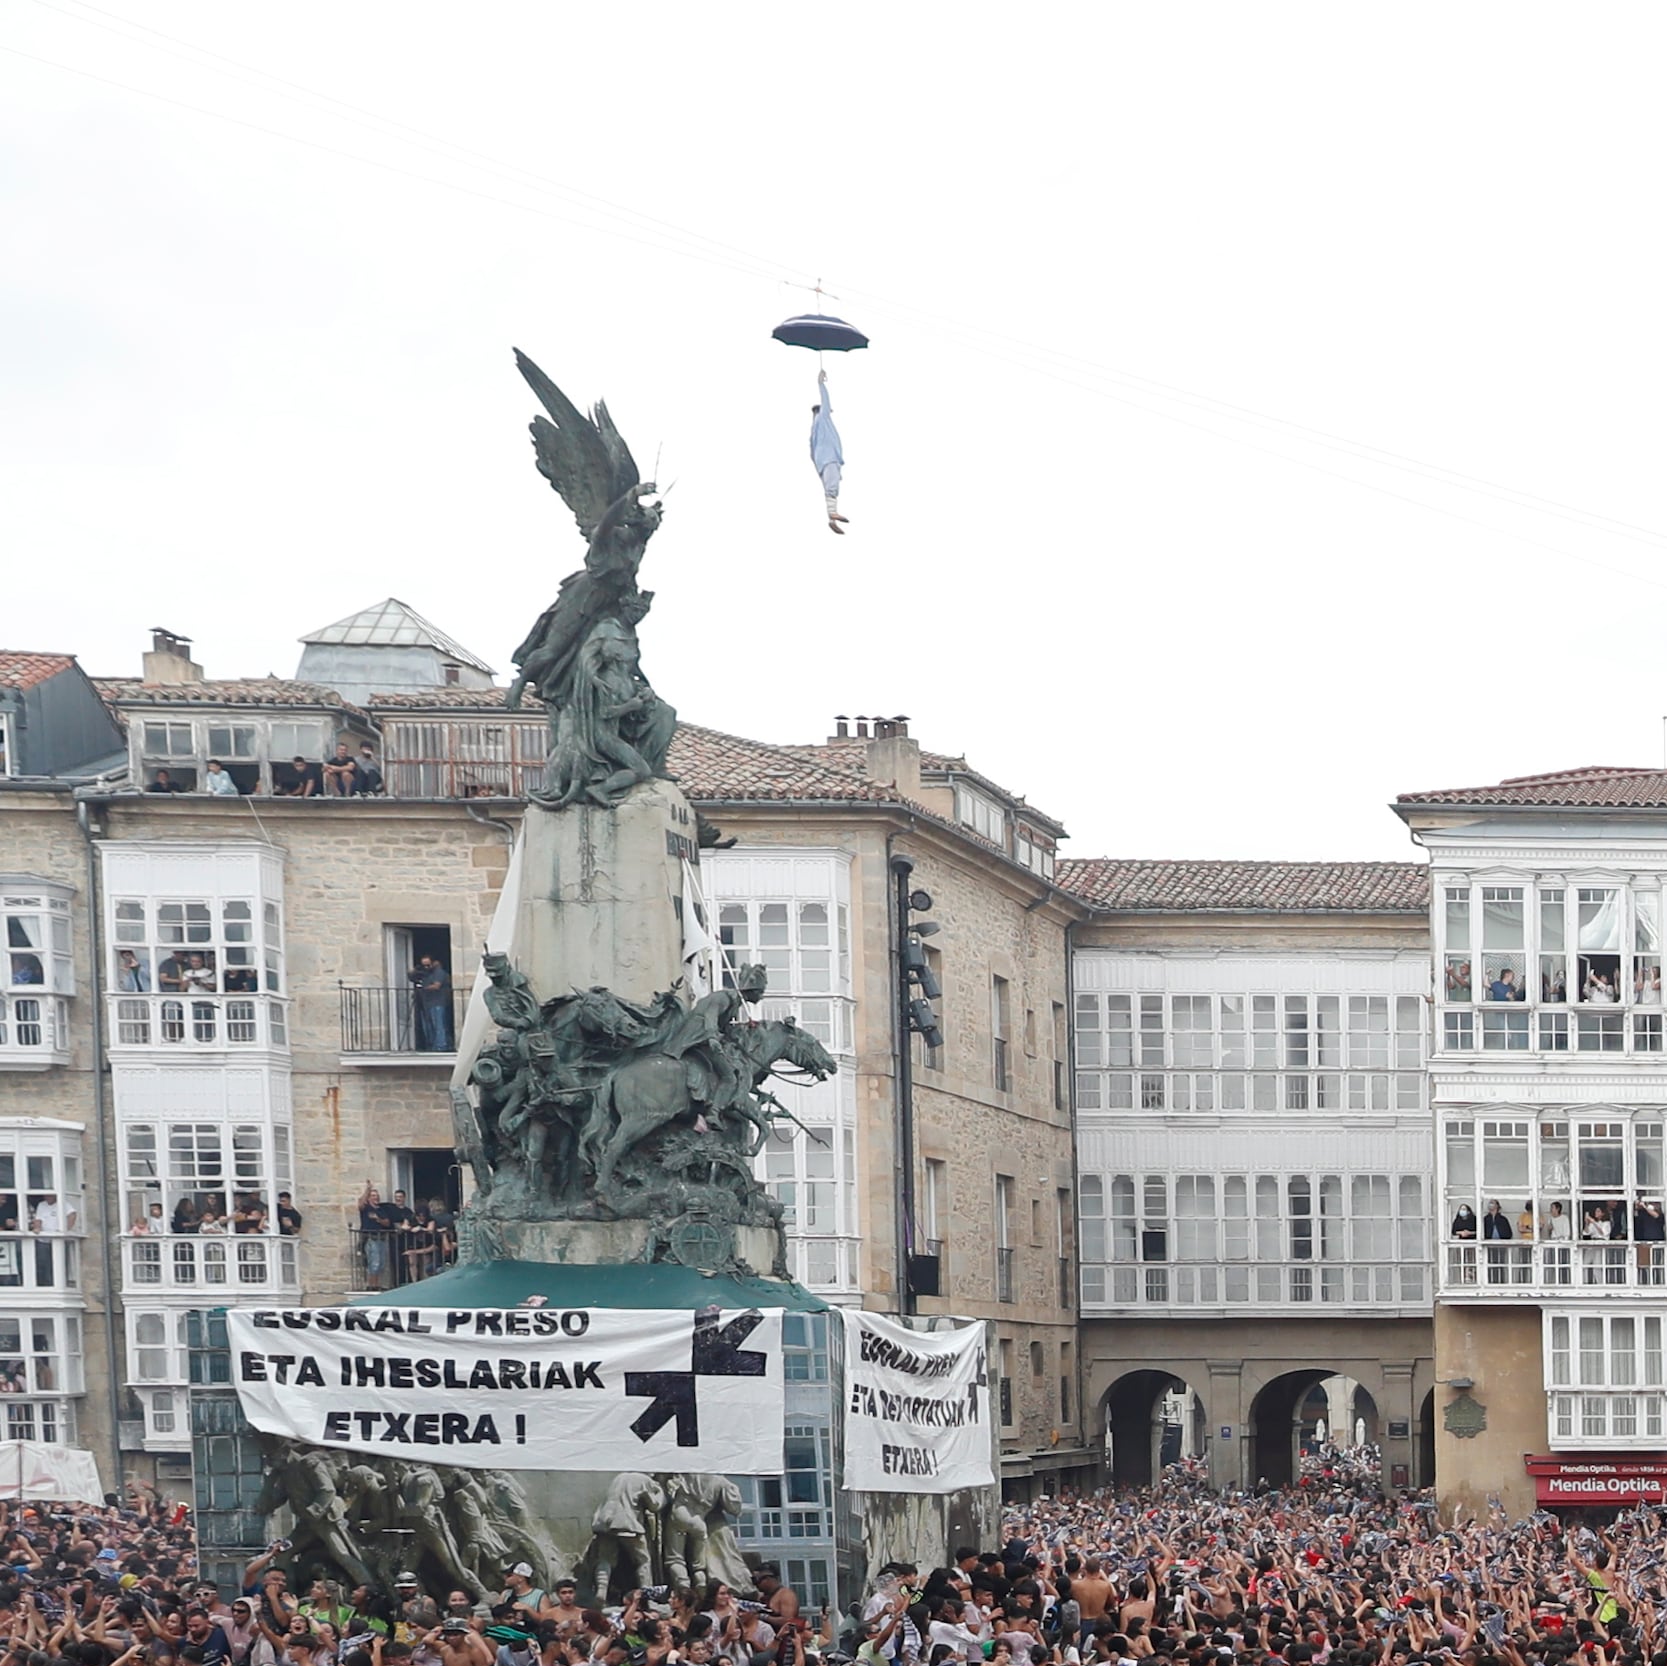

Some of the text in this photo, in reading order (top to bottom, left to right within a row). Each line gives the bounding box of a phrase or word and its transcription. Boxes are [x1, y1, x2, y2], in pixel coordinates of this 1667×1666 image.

[253, 1309, 590, 1337] EUSKAL PRESO
[240, 1351, 606, 1390] ETA IHESLARIAK
[322, 1411, 501, 1445] ETXERA
[882, 1443, 933, 1476] ETXERA
[1560, 1465, 1589, 1473] Mendia
[1590, 1465, 1617, 1474] Optika
[1549, 1478, 1607, 1492] Mendia
[1607, 1478, 1661, 1495] Optika
